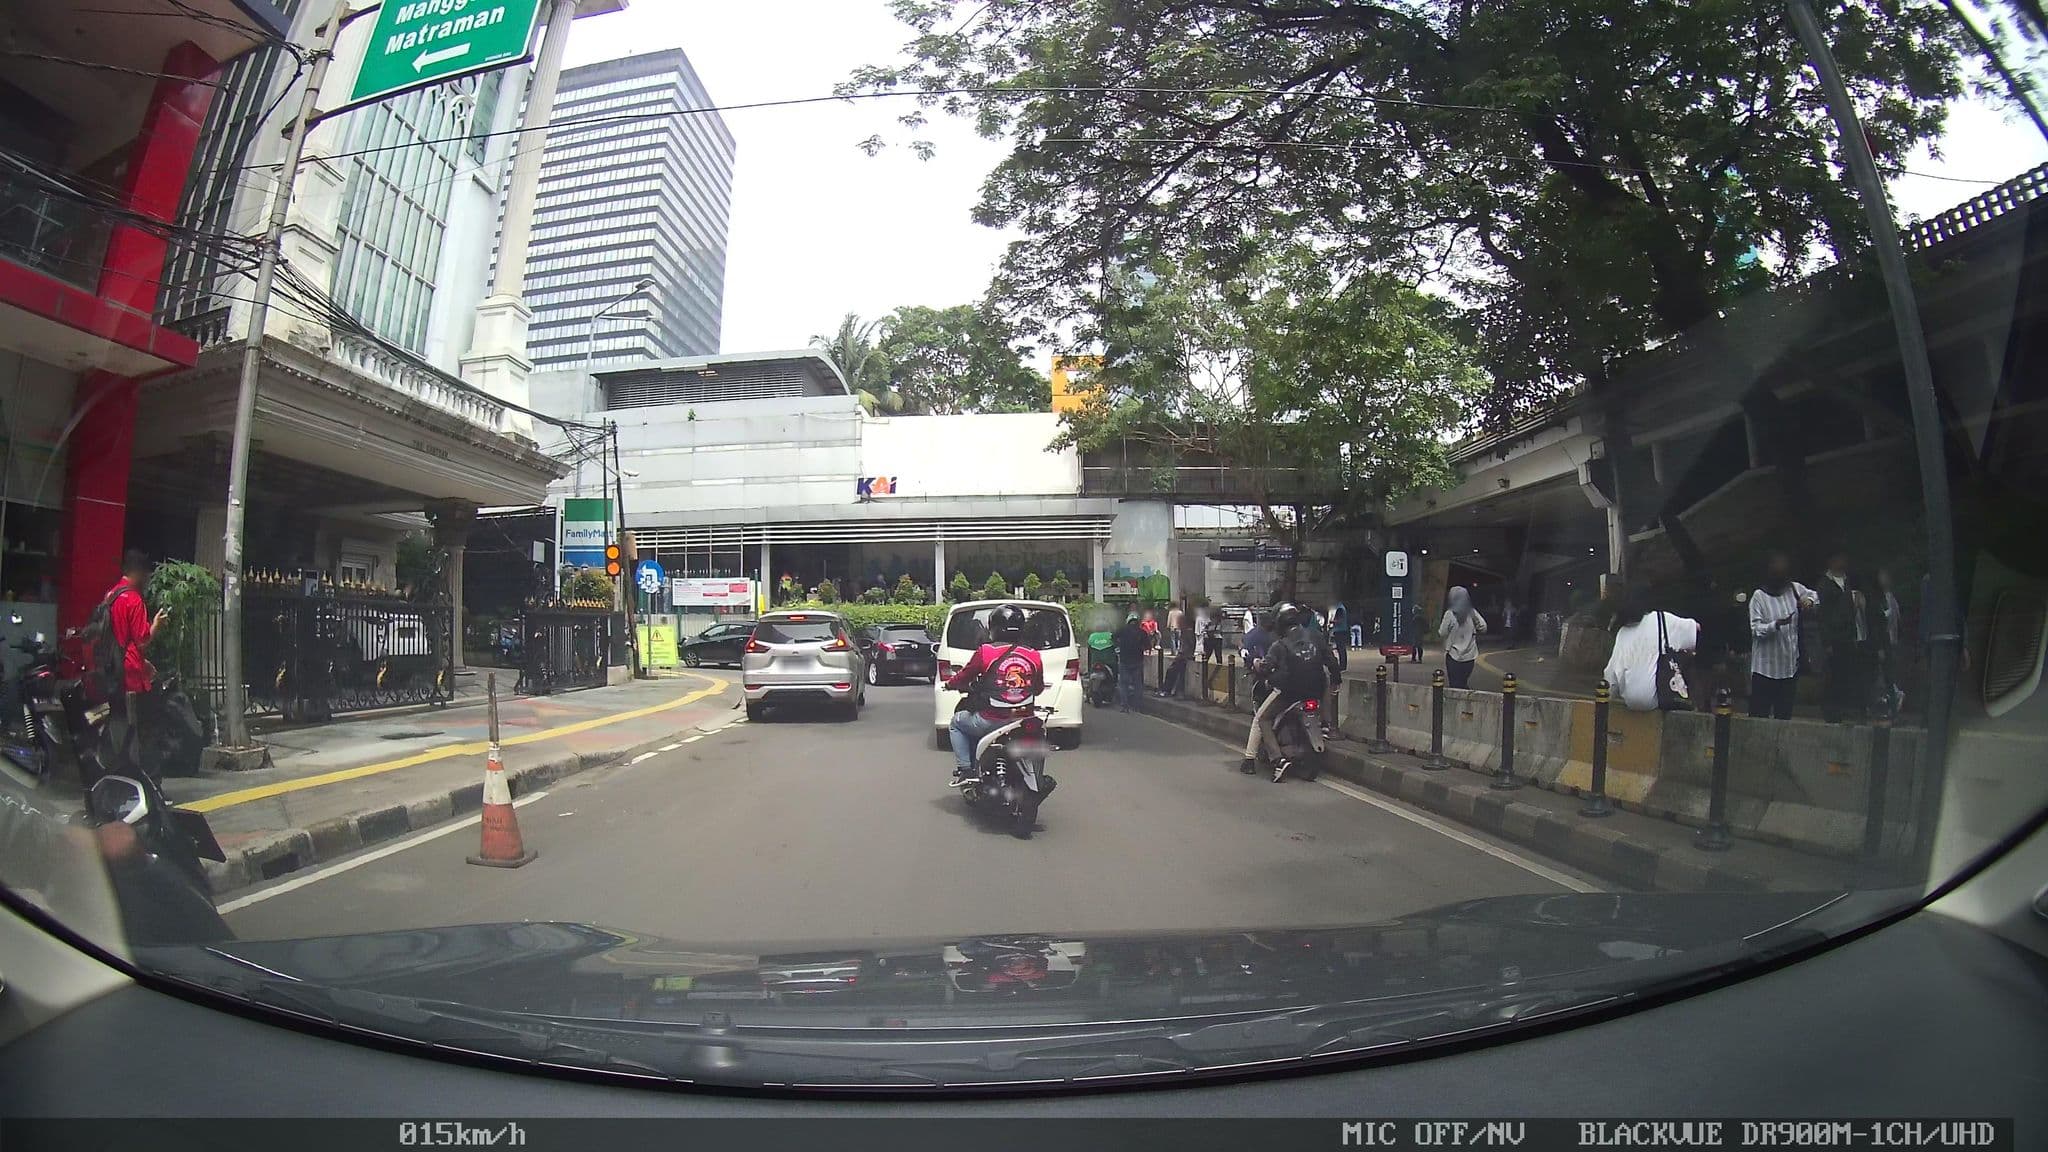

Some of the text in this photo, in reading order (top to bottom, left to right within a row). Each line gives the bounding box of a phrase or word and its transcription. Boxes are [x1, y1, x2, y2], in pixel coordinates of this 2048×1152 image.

[395, 0, 476, 25] Mangg
[384, 6, 506, 56] Matraman
[565, 529, 614, 539] FamilyMat
